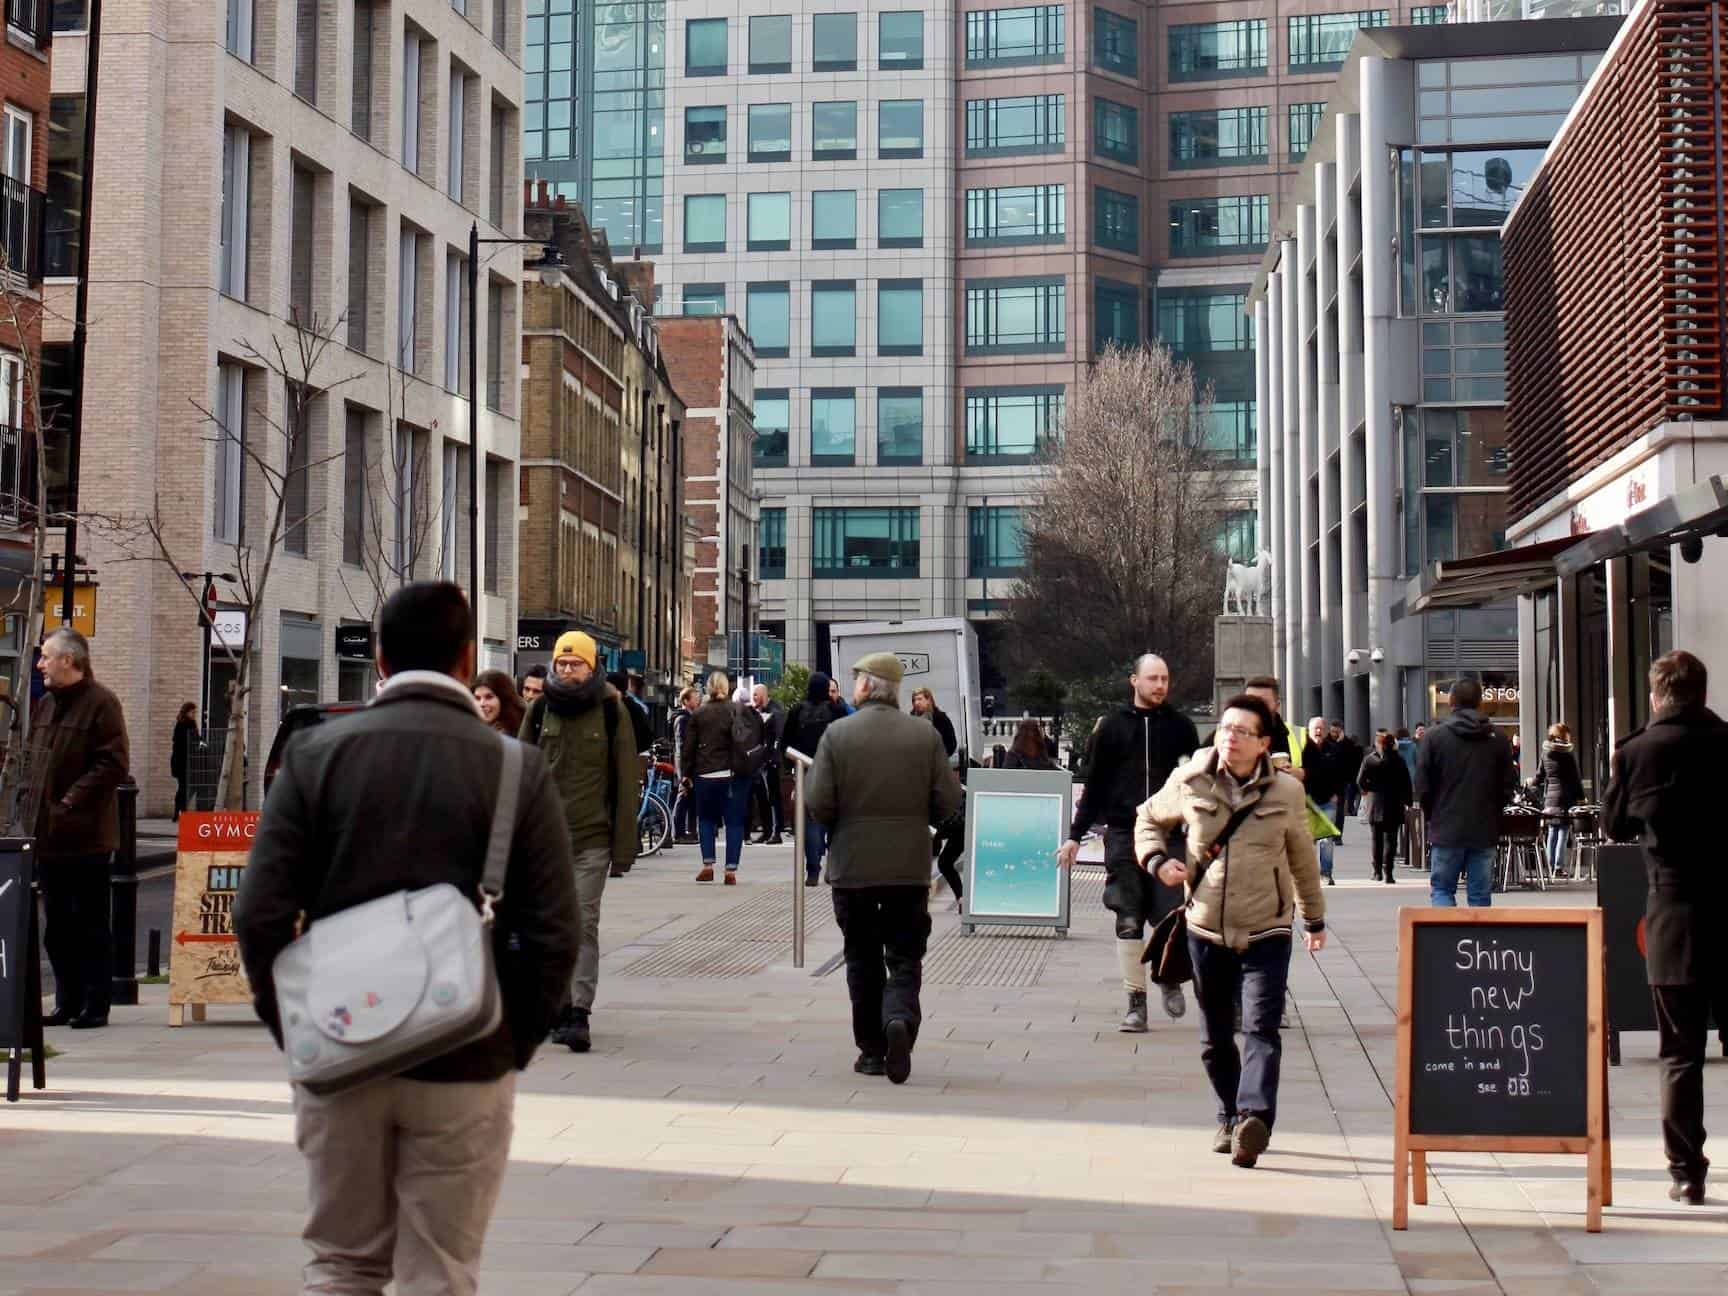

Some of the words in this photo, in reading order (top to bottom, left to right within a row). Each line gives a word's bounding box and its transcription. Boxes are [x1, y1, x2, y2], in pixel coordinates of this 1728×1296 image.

[53, 604, 86, 617] ET.
[1455, 938, 1535, 996] Shiny
[1471, 986, 1525, 1010] new
[1445, 1014, 1544, 1077] things
[1424, 1062, 1455, 1072] come
[1463, 1056, 1474, 1070] in
[1479, 1058, 1501, 1070] and
[1477, 1082, 1497, 1094] see
